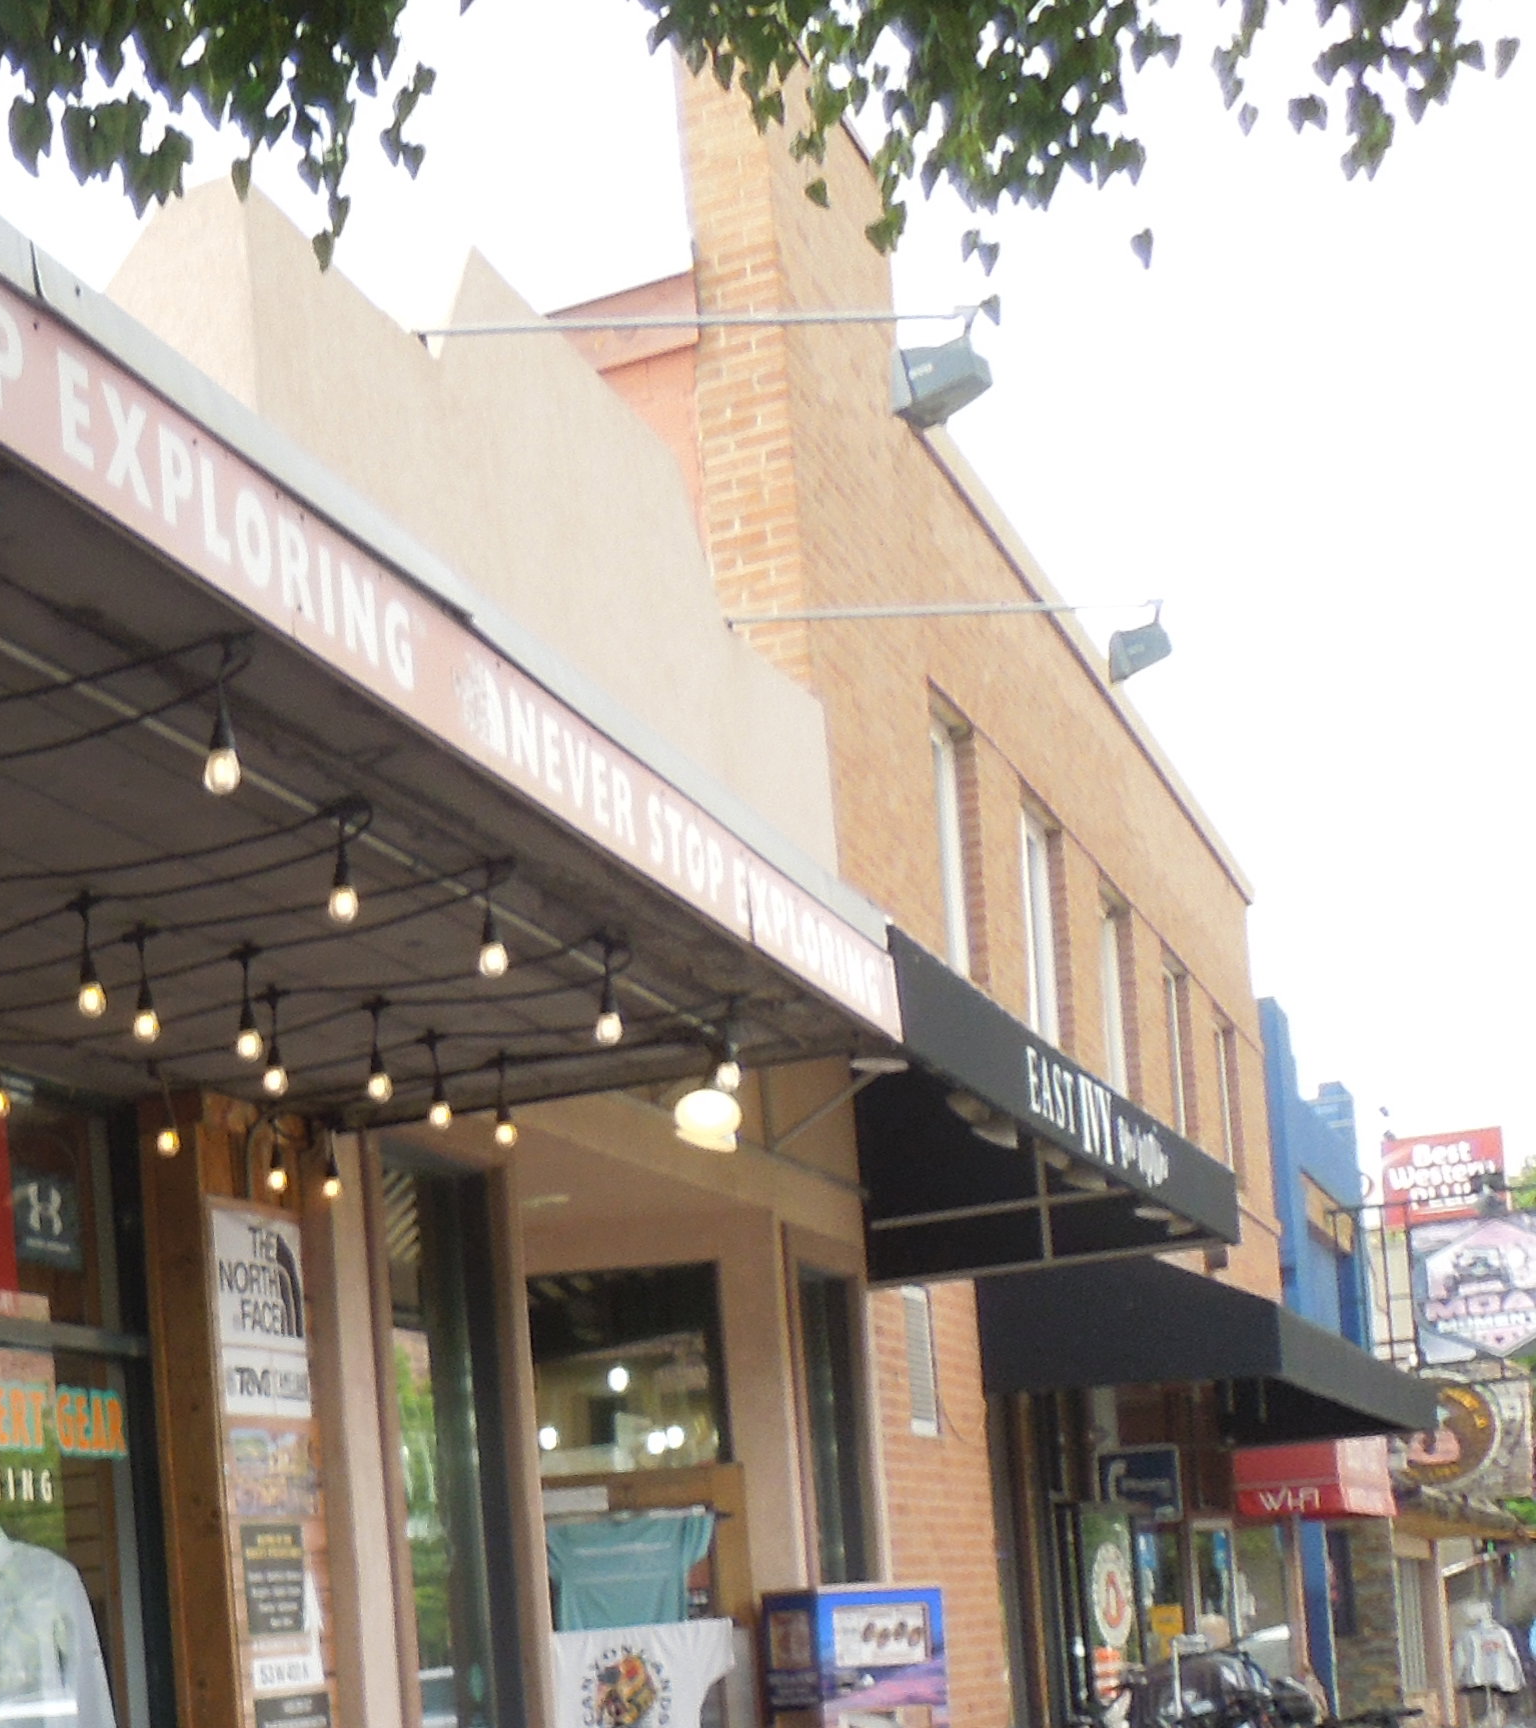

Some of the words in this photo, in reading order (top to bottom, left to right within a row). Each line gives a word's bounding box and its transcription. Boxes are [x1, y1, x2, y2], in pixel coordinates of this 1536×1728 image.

[56, 347, 415, 692] EXPLORING
[508, 689, 636, 846] NEVER
[648, 793, 724, 902] STOP
[733, 859, 883, 1016] EXPLORING
[1026, 1045, 1076, 1134] EAST
[1412, 1141, 1472, 1167] Best
[248, 1226, 277, 1262] THE
[219, 1260, 280, 1299] NORTH
[240, 1298, 280, 1336] FACE
[56, 1383, 128, 1459] GEAR
